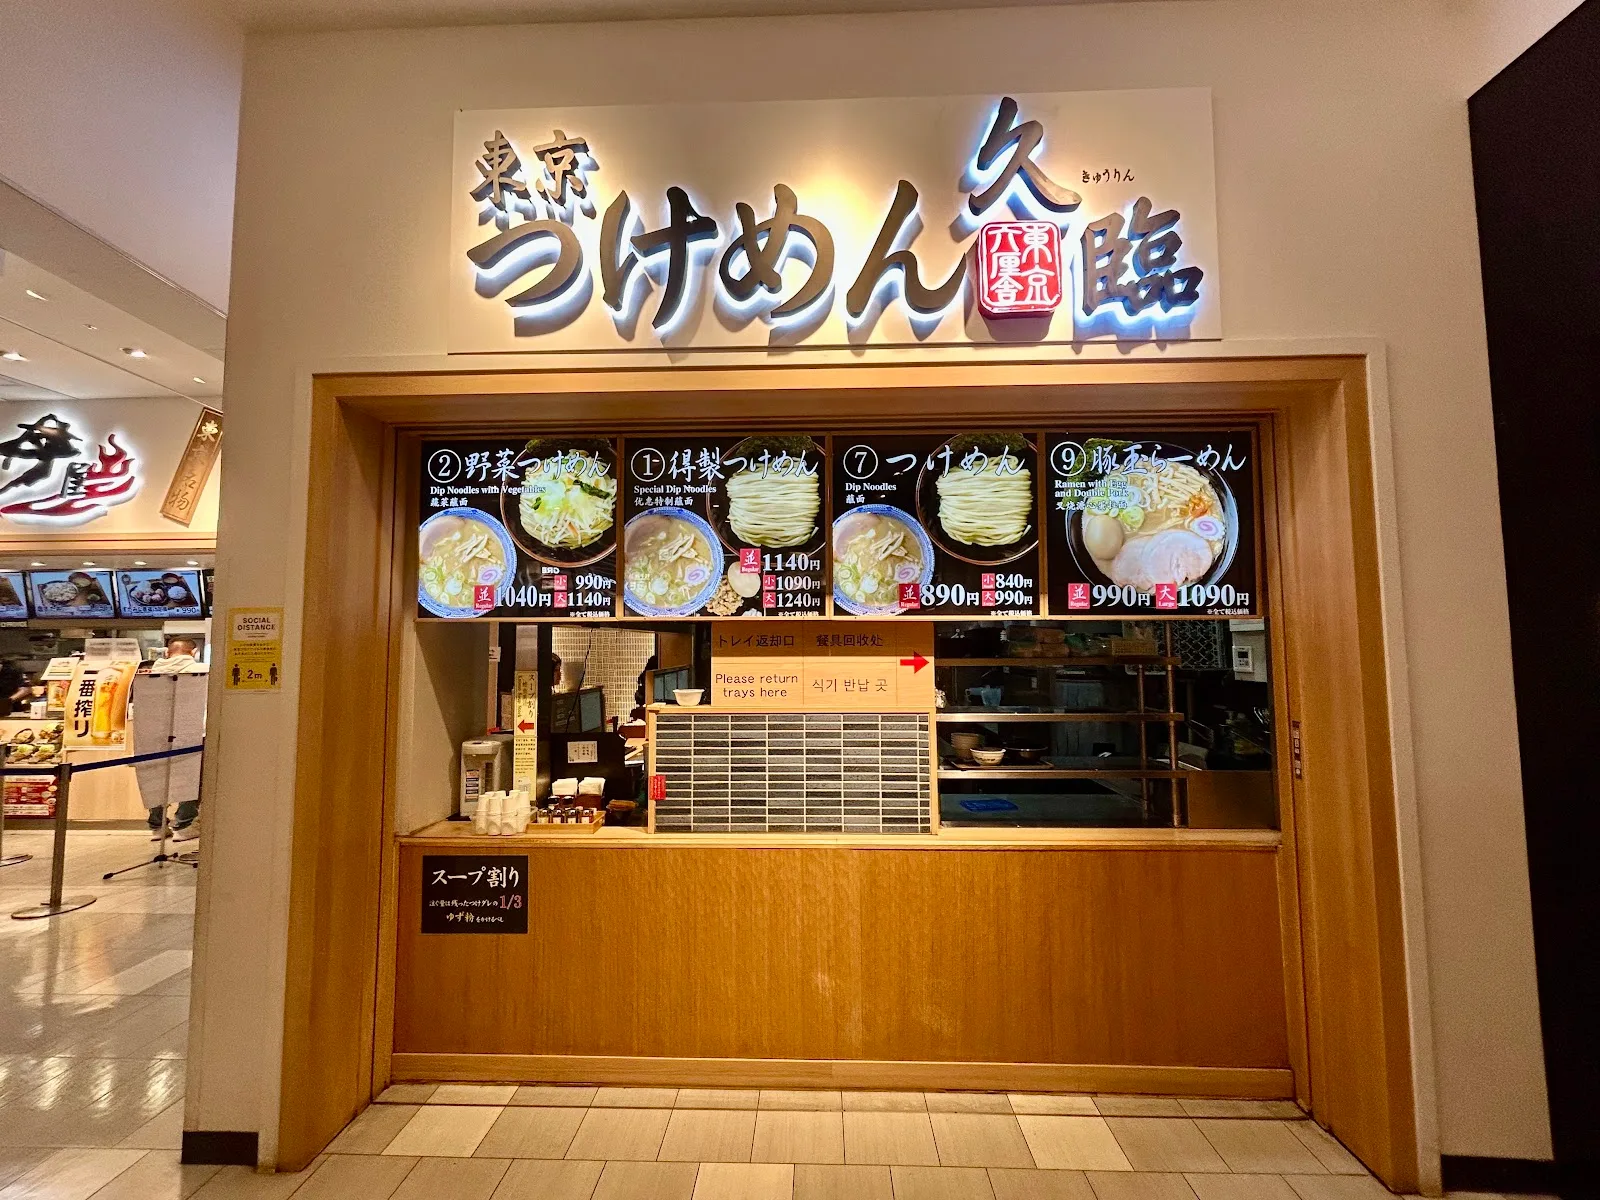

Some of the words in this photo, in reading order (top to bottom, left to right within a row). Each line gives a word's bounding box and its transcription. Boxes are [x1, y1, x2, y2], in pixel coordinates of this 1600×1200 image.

[471, 130, 598, 218] 東京
[1081, 168, 1134, 184] きゅうりん
[466, 179, 968, 328] つけめん
[465, 448, 611, 482] 野菜つけめん
[668, 447, 819, 482] 得製つけめん
[886, 445, 1025, 478] つけめん
[430, 487, 446, 496] Dip
[447, 486, 479, 495] Noodles
[481, 486, 499, 494] with
[501, 486, 546, 496] Vegetables
[634, 485, 664, 495] Special
[666, 485, 681, 495] Dip
[683, 485, 716, 494] Noodles
[845, 483, 861, 492] Dip
[863, 482, 896, 491] Noodles
[1055, 480, 1086, 488] Ramen
[1088, 479, 1107, 488] with
[1055, 489, 1071, 497] and
[1074, 489, 1105, 497] Double
[763, 553, 820, 572] 1140円
[776, 575, 820, 591] 1090円
[995, 573, 1032, 588] 840円
[496, 585, 551, 607] 1040円
[567, 591, 611, 607] 1140円
[776, 592, 821, 608] 1240円
[921, 583, 979, 606] 890円
[994, 590, 1033, 606] 990円
[1092, 584, 1150, 607] 990円
[1178, 584, 1249, 607] 1090円
[718, 634, 795, 647] トレイ返却口
[816, 634, 884, 647] 餐具回收处
[715, 673, 755, 684] Please
[760, 674, 798, 684] return
[812, 678, 837, 693] 식기
[844, 678, 870, 693] 반납
[875, 678, 888, 693] 곳
[723, 688, 755, 698] trays
[760, 687, 788, 697] here
[74, 670, 99, 738] 一番搾り
[432, 865, 520, 888] スープ割り
